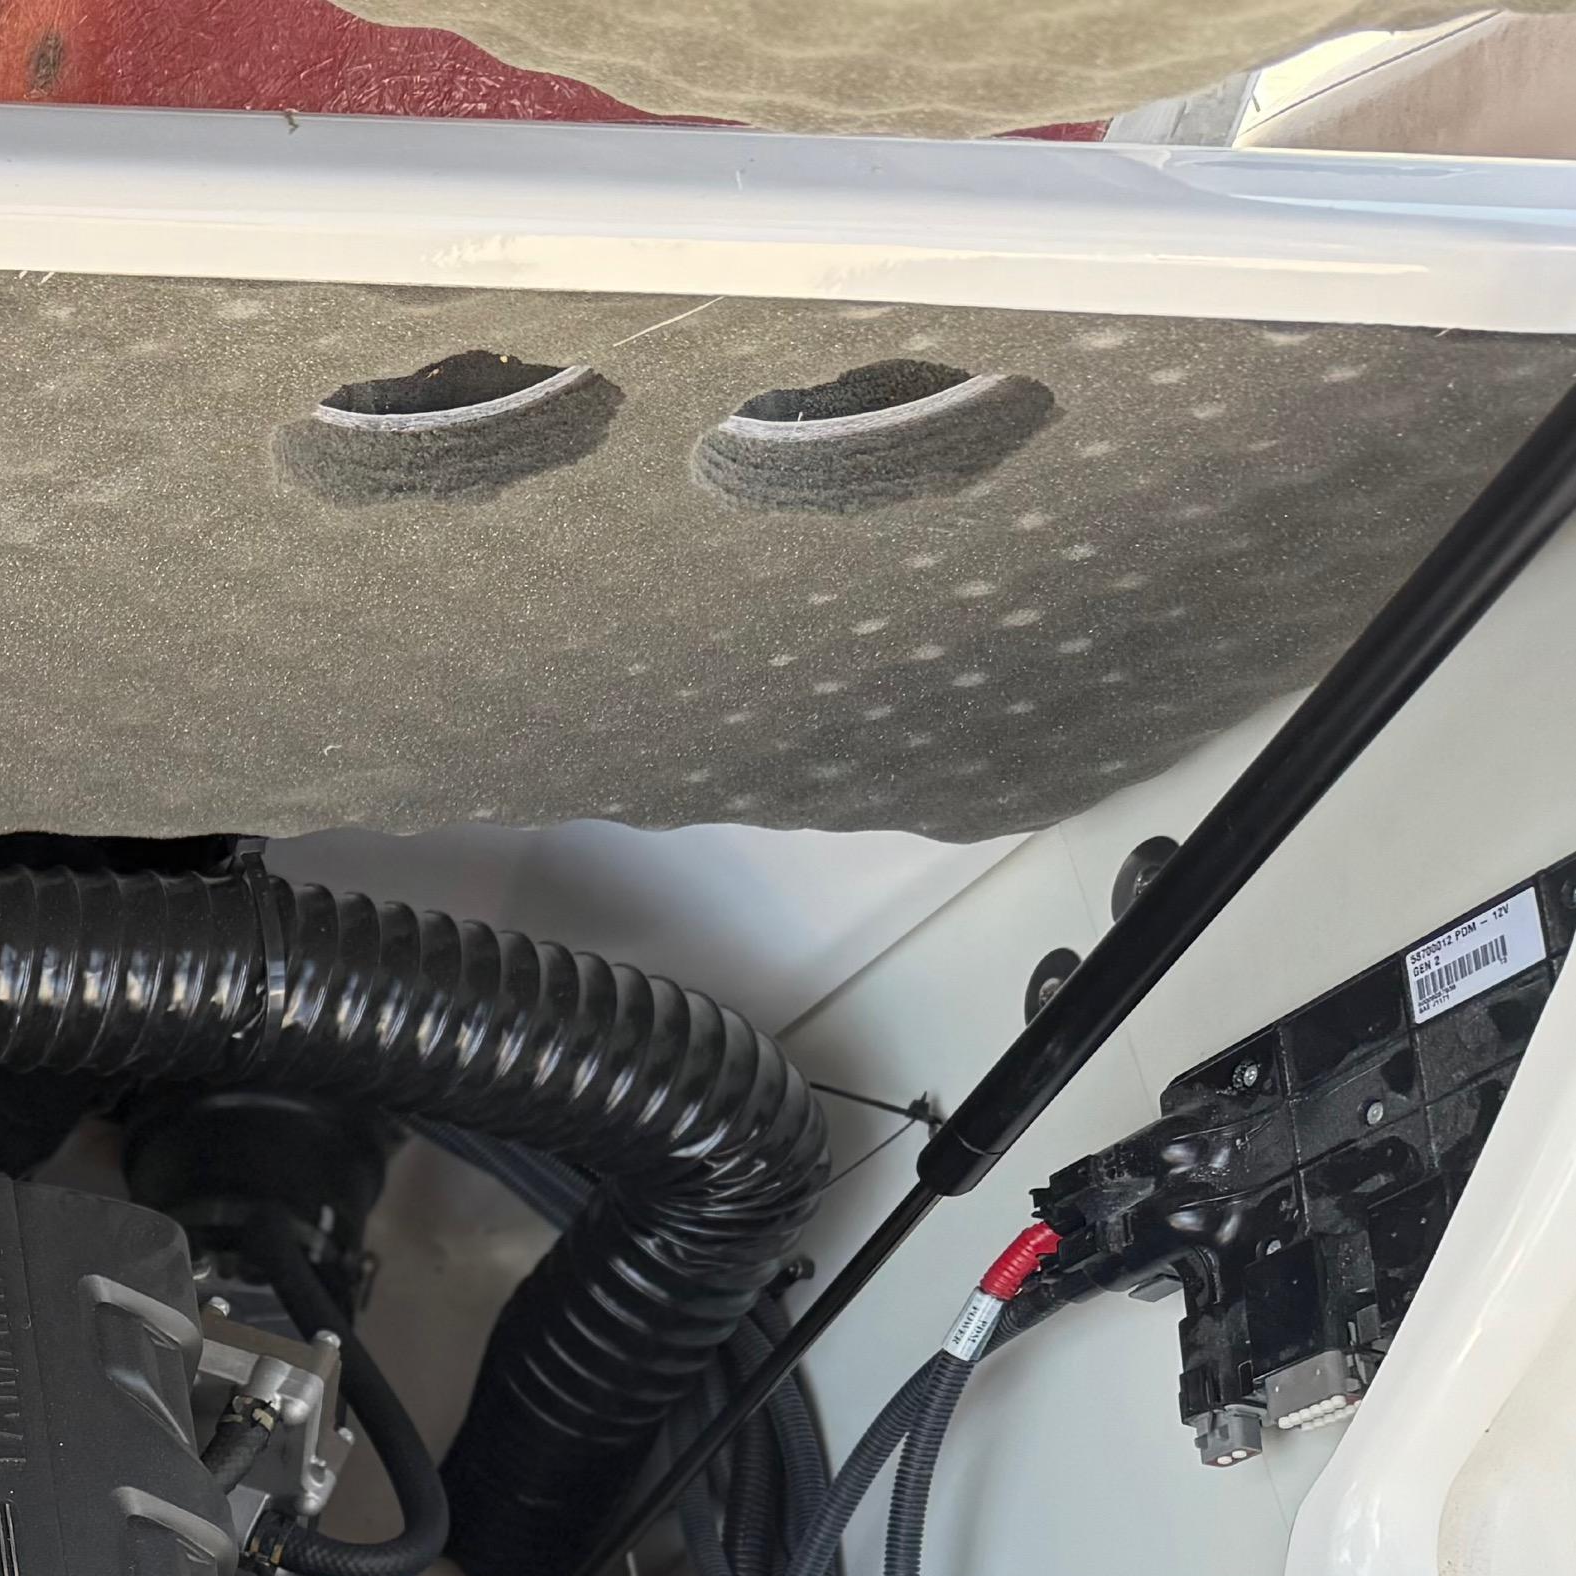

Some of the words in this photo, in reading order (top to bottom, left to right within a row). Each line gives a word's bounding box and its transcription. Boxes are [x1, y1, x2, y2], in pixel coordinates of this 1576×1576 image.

[1455, 922, 1477, 942] PDM
[1493, 903, 1510, 920] 12V
[1413, 961, 1432, 977] GEN
[1434, 955, 1441, 967] 2
[952, 1306, 980, 1345] POWER
[967, 1320, 988, 1343] PDM
